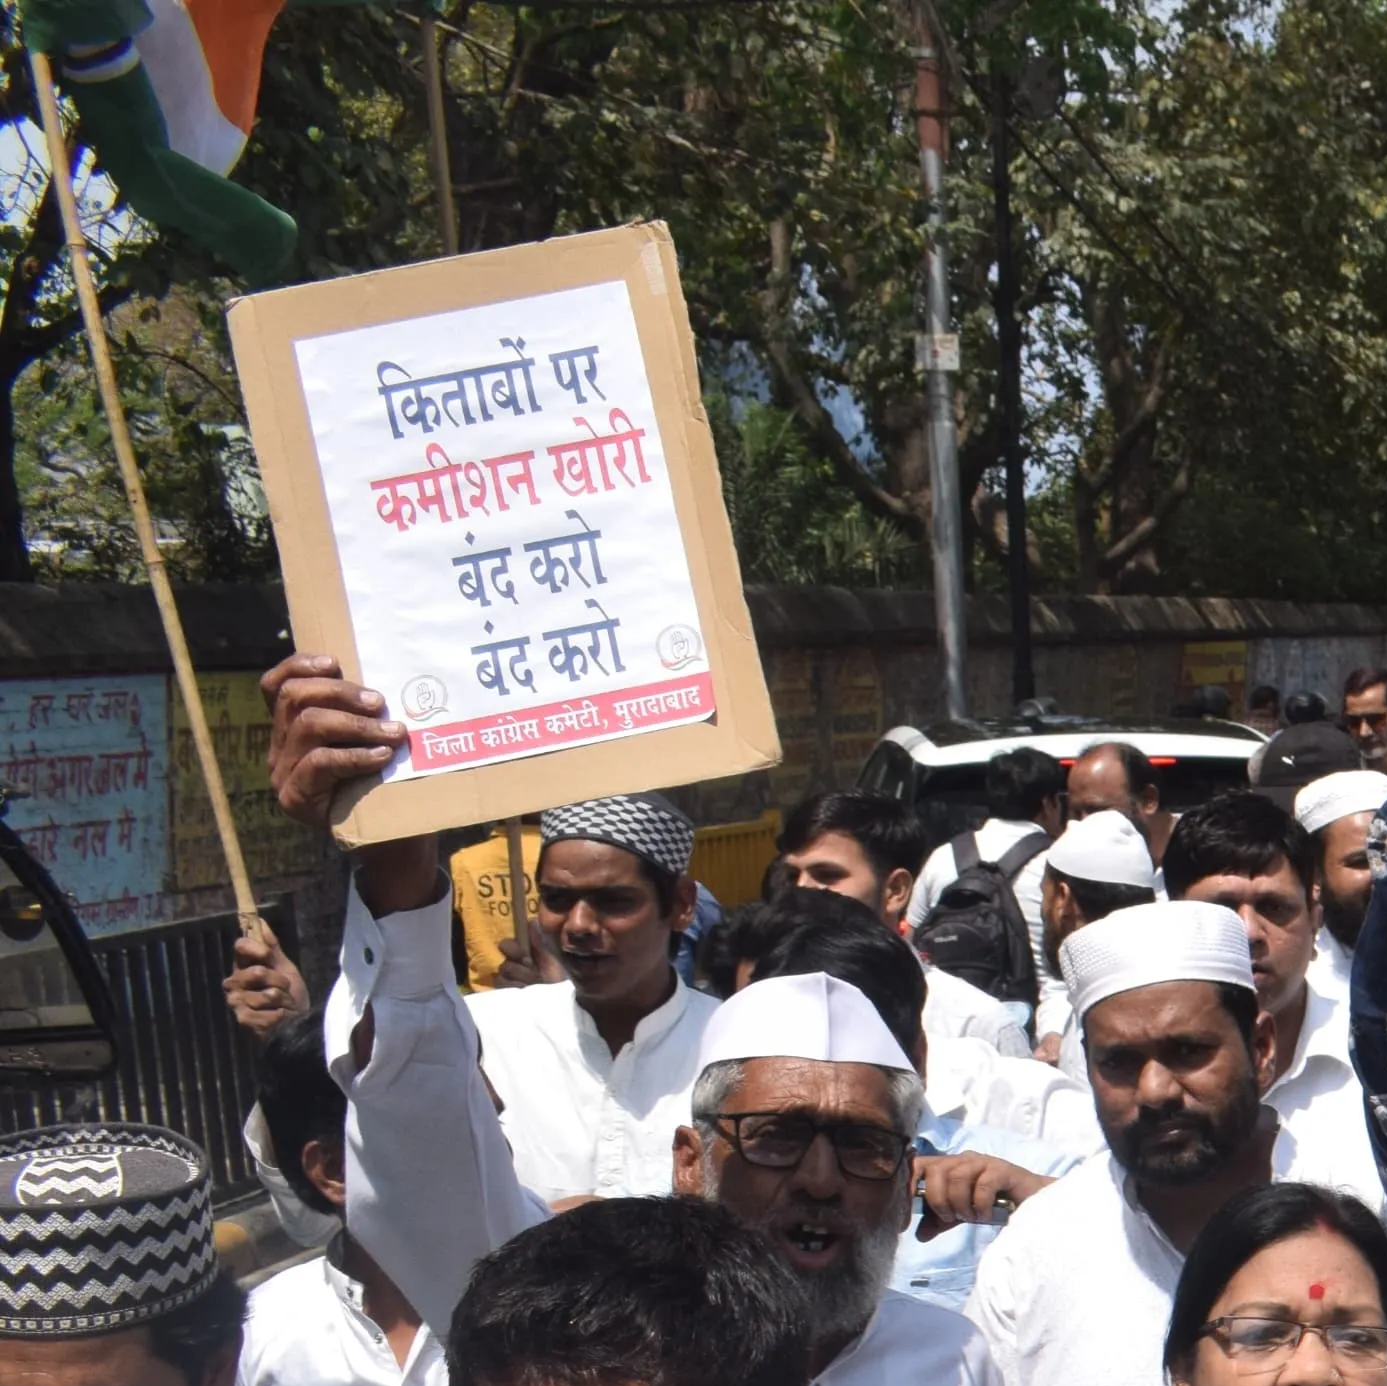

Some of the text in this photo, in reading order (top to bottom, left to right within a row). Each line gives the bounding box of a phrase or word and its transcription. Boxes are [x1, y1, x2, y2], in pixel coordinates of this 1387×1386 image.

[377, 337, 607, 439] किताबों पर
[371, 407, 652, 531] कमीशन खोरी
[452, 509, 608, 606] बंद करो
[471, 599, 627, 696] बंद करो
[422, 685, 700, 759] जिला कांग्रेस कमेटी, मुरादाबाद
